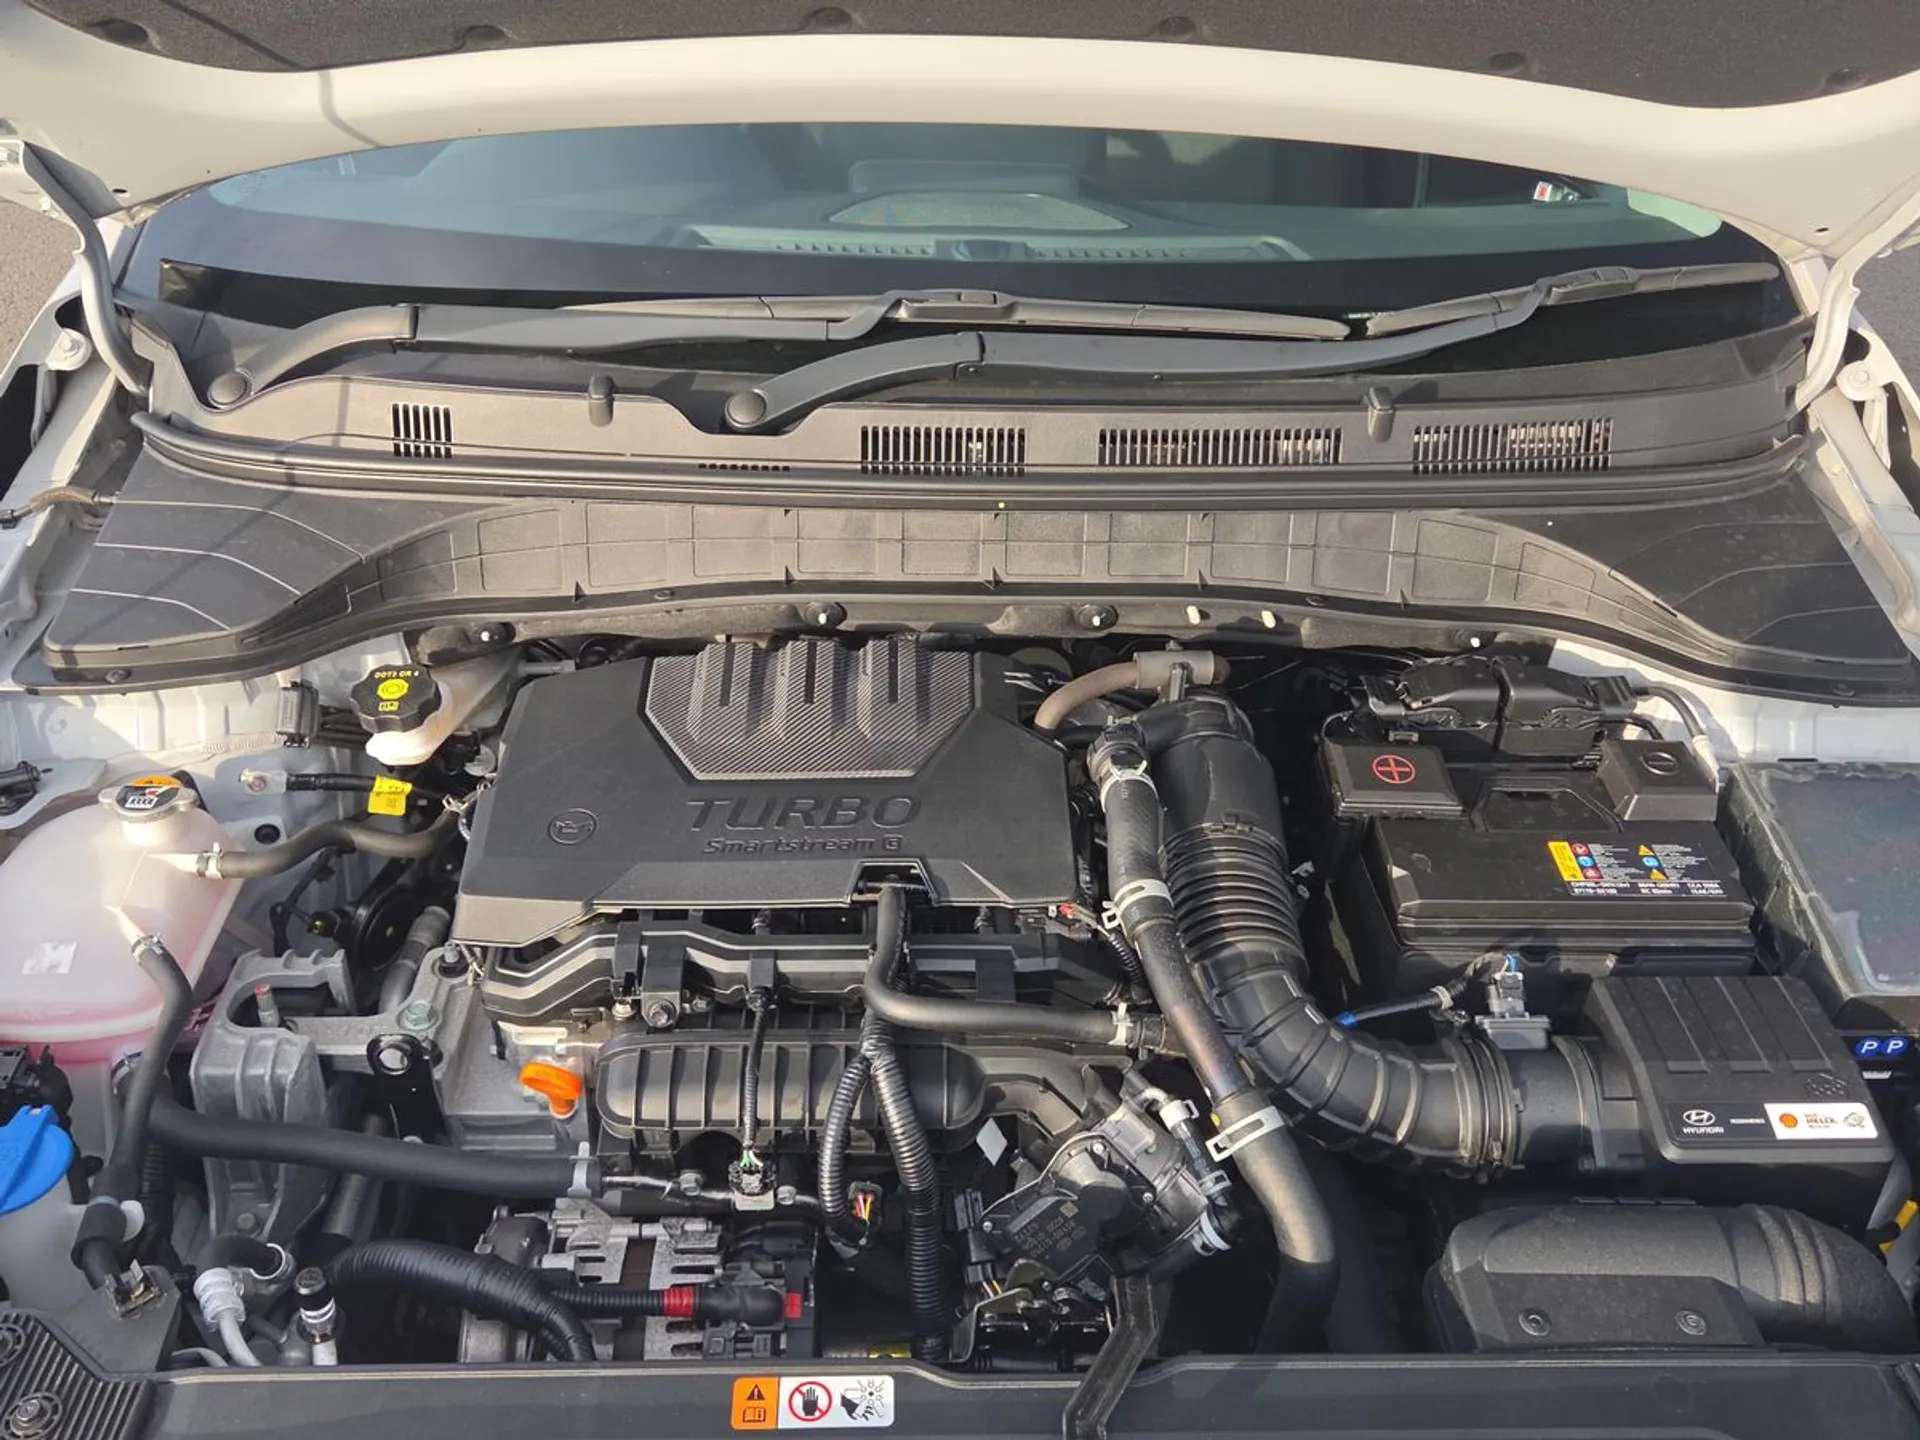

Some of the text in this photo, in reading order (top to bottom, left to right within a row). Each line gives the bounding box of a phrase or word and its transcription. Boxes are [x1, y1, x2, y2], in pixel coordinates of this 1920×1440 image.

[687, 795, 921, 832] TURBO
[703, 836, 876, 855] Smartstream
[1861, 1039, 1904, 1054] P P
[1682, 1126, 1725, 1135] HYUNDAI
